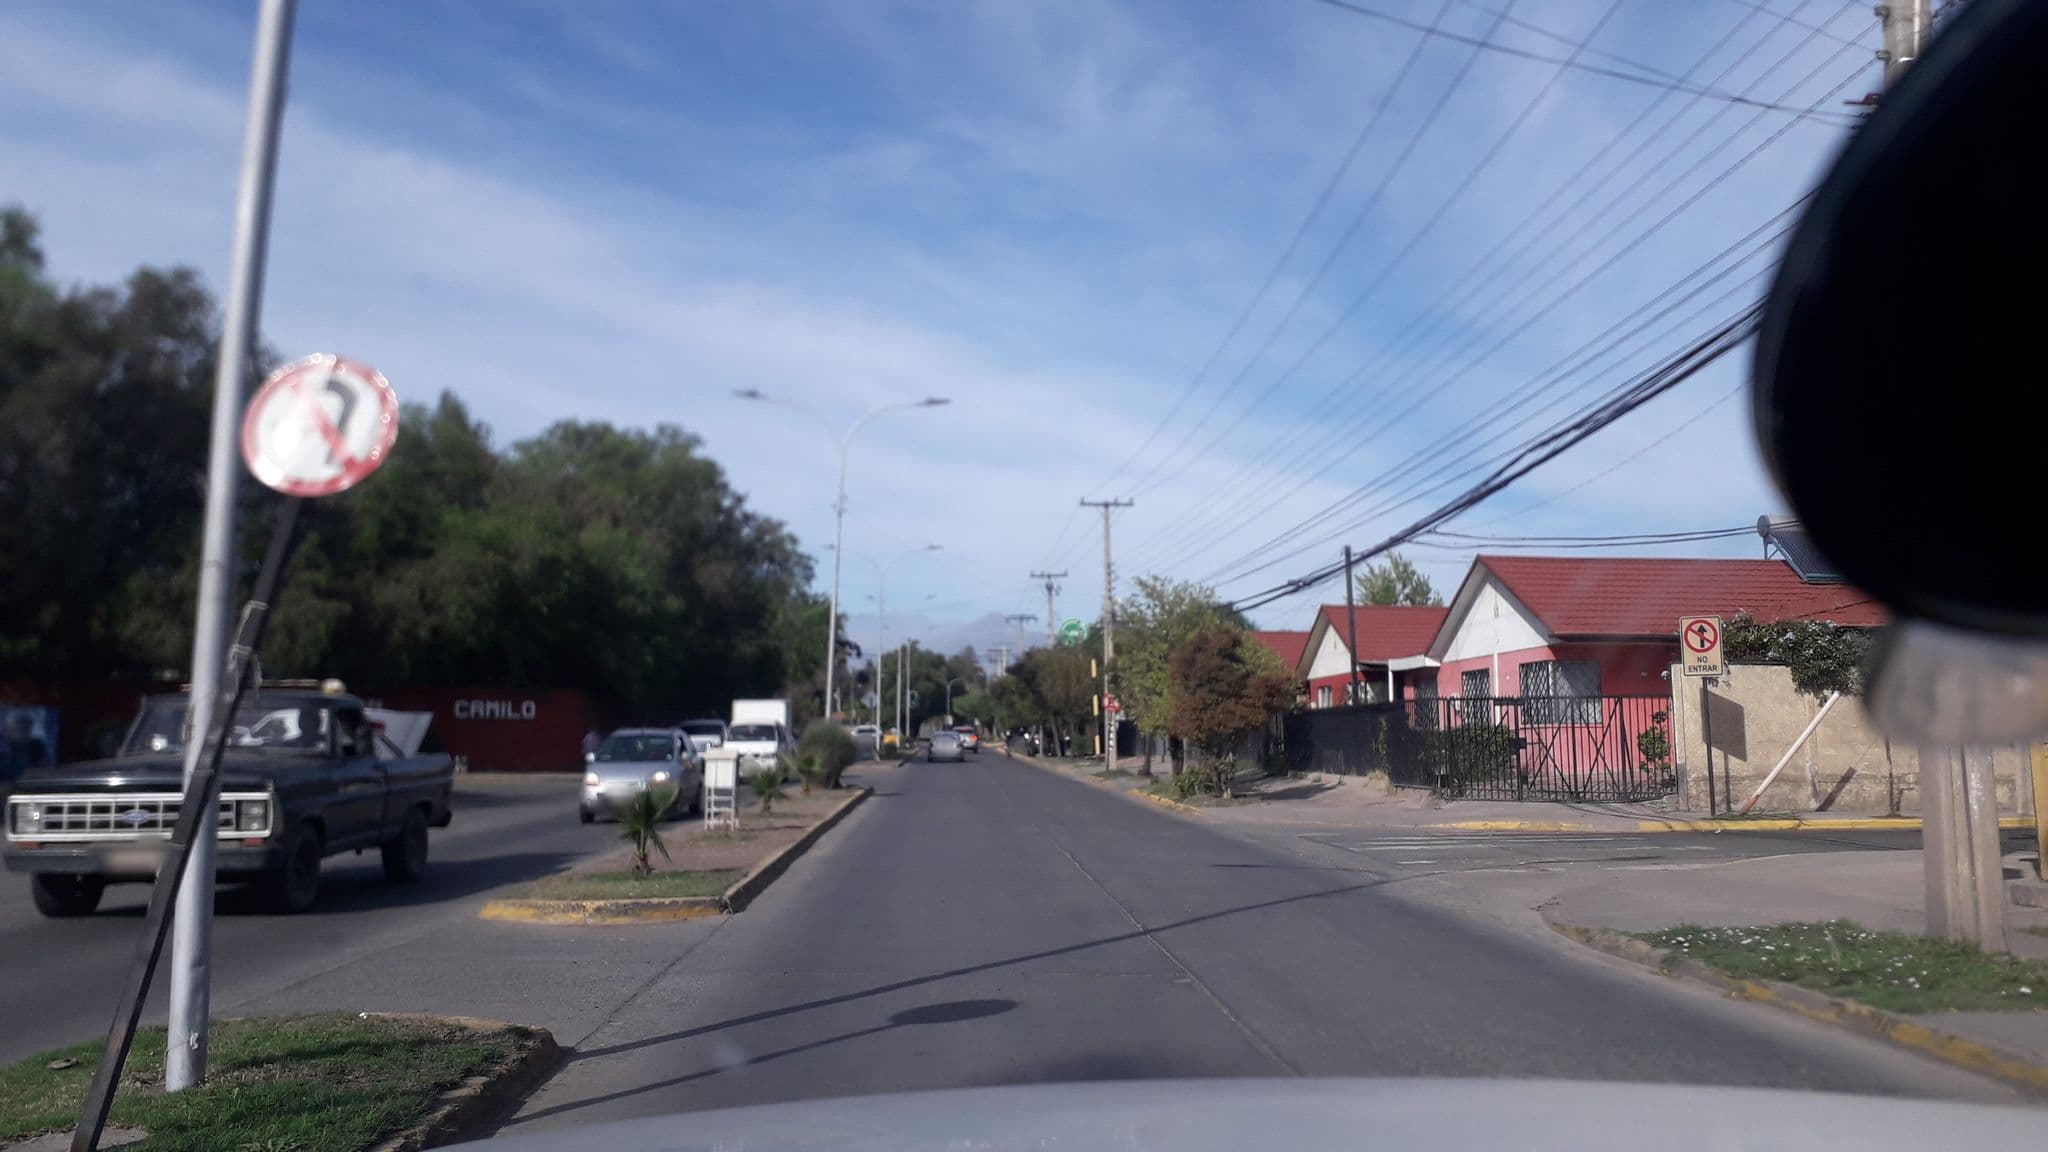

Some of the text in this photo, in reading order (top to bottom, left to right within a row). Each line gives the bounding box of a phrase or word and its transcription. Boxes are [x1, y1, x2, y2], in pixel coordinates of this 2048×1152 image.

[1697, 656, 1708, 664] NO
[1688, 665, 1718, 673] ENTRAR
[454, 699, 536, 720] CAMILO
